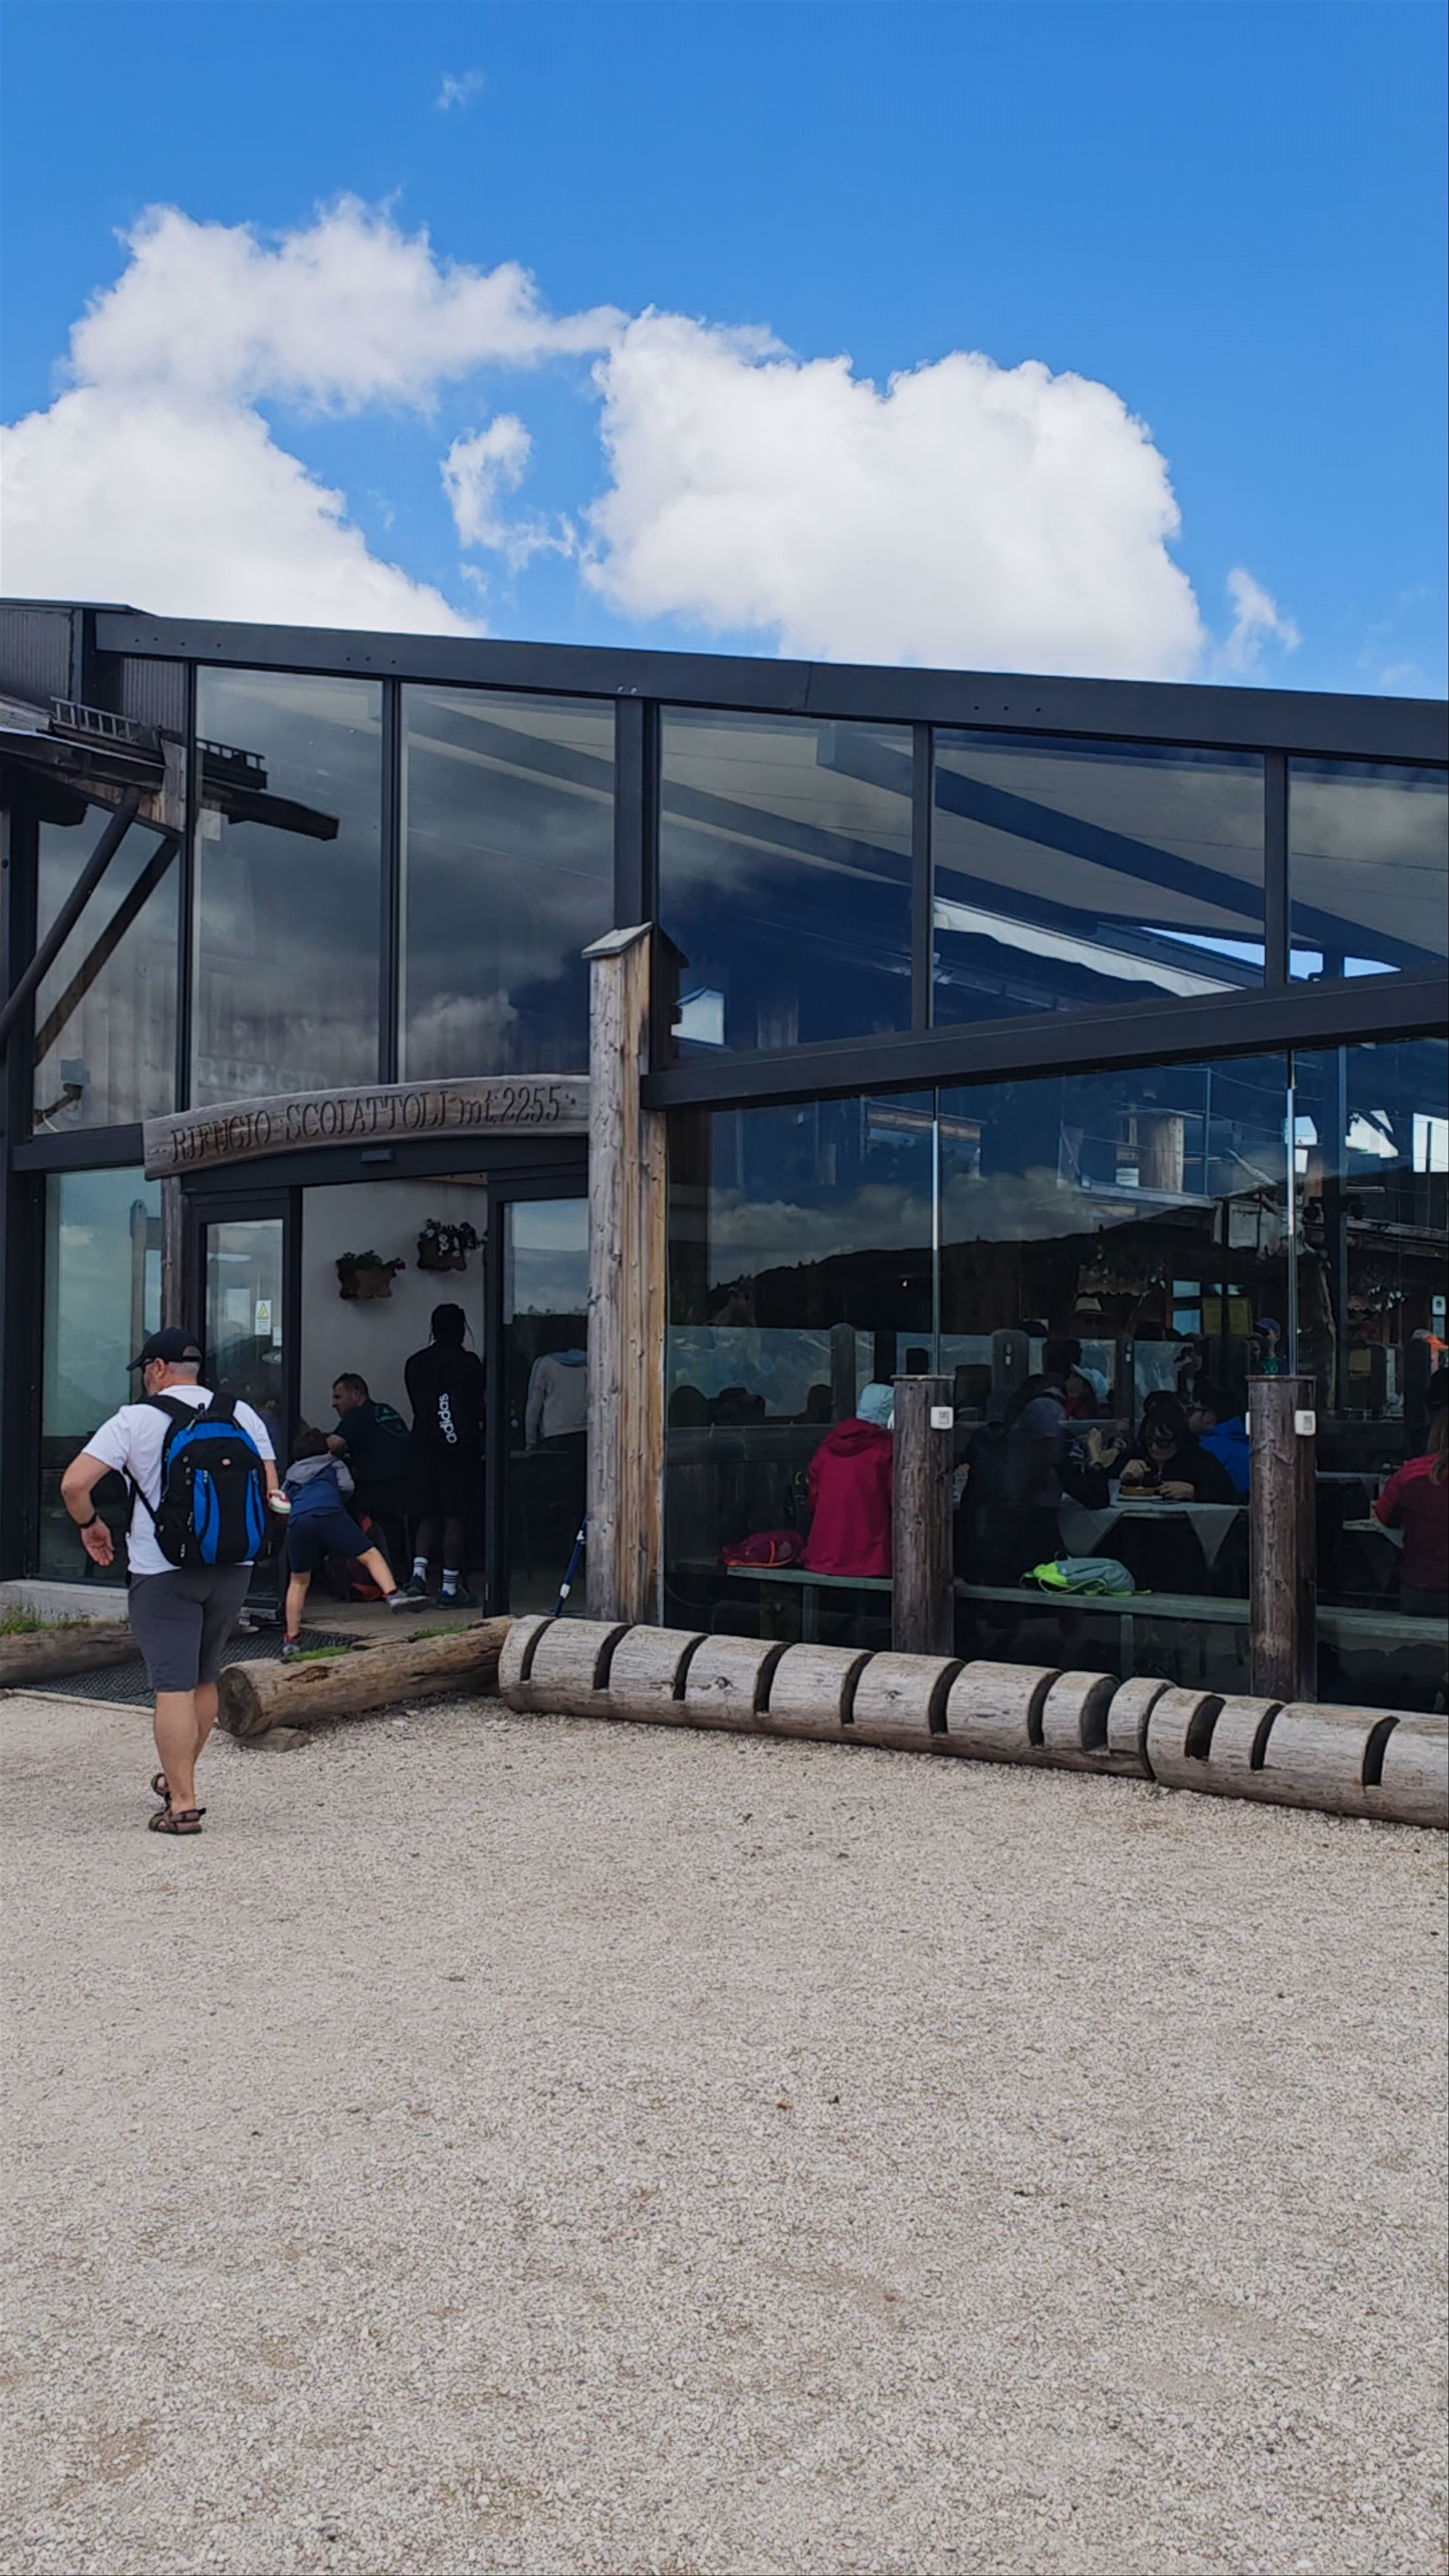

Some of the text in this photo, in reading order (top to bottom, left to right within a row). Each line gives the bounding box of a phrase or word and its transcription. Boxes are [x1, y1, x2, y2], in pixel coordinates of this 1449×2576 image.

[171, 1110, 271, 1163] RIFUGIO
[286, 1090, 449, 1140] SCOIATTOLI
[438, 1393, 457, 1443] adidas
